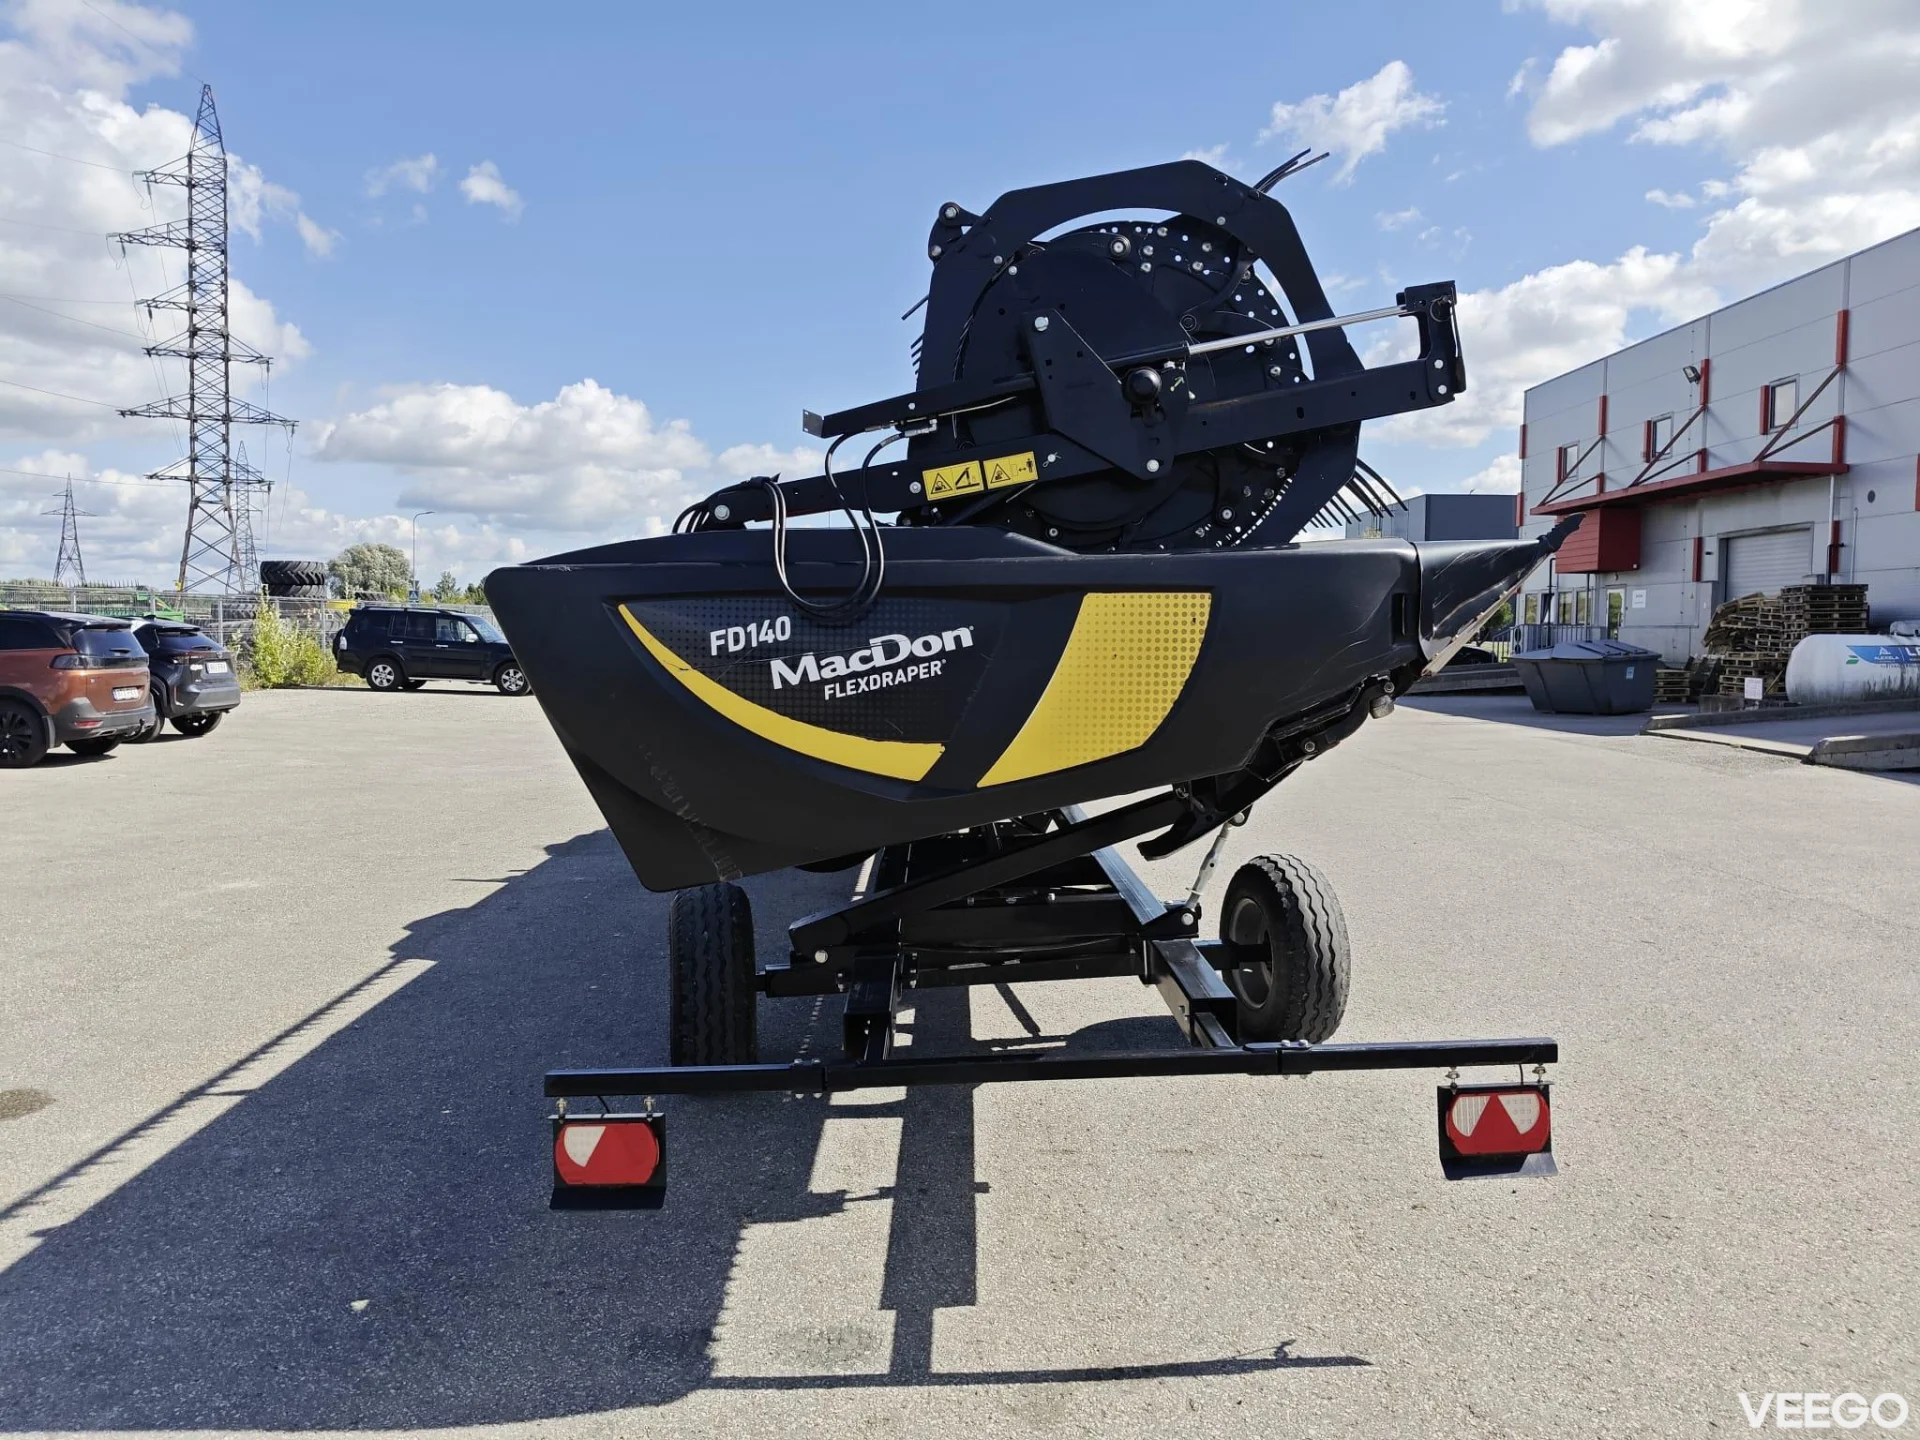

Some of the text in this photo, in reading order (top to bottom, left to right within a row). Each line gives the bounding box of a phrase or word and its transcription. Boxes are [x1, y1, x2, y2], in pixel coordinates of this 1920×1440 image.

[710, 615, 791, 656] FD140
[770, 625, 974, 690] MacDon
[824, 659, 944, 701] FLEXDRAPER
